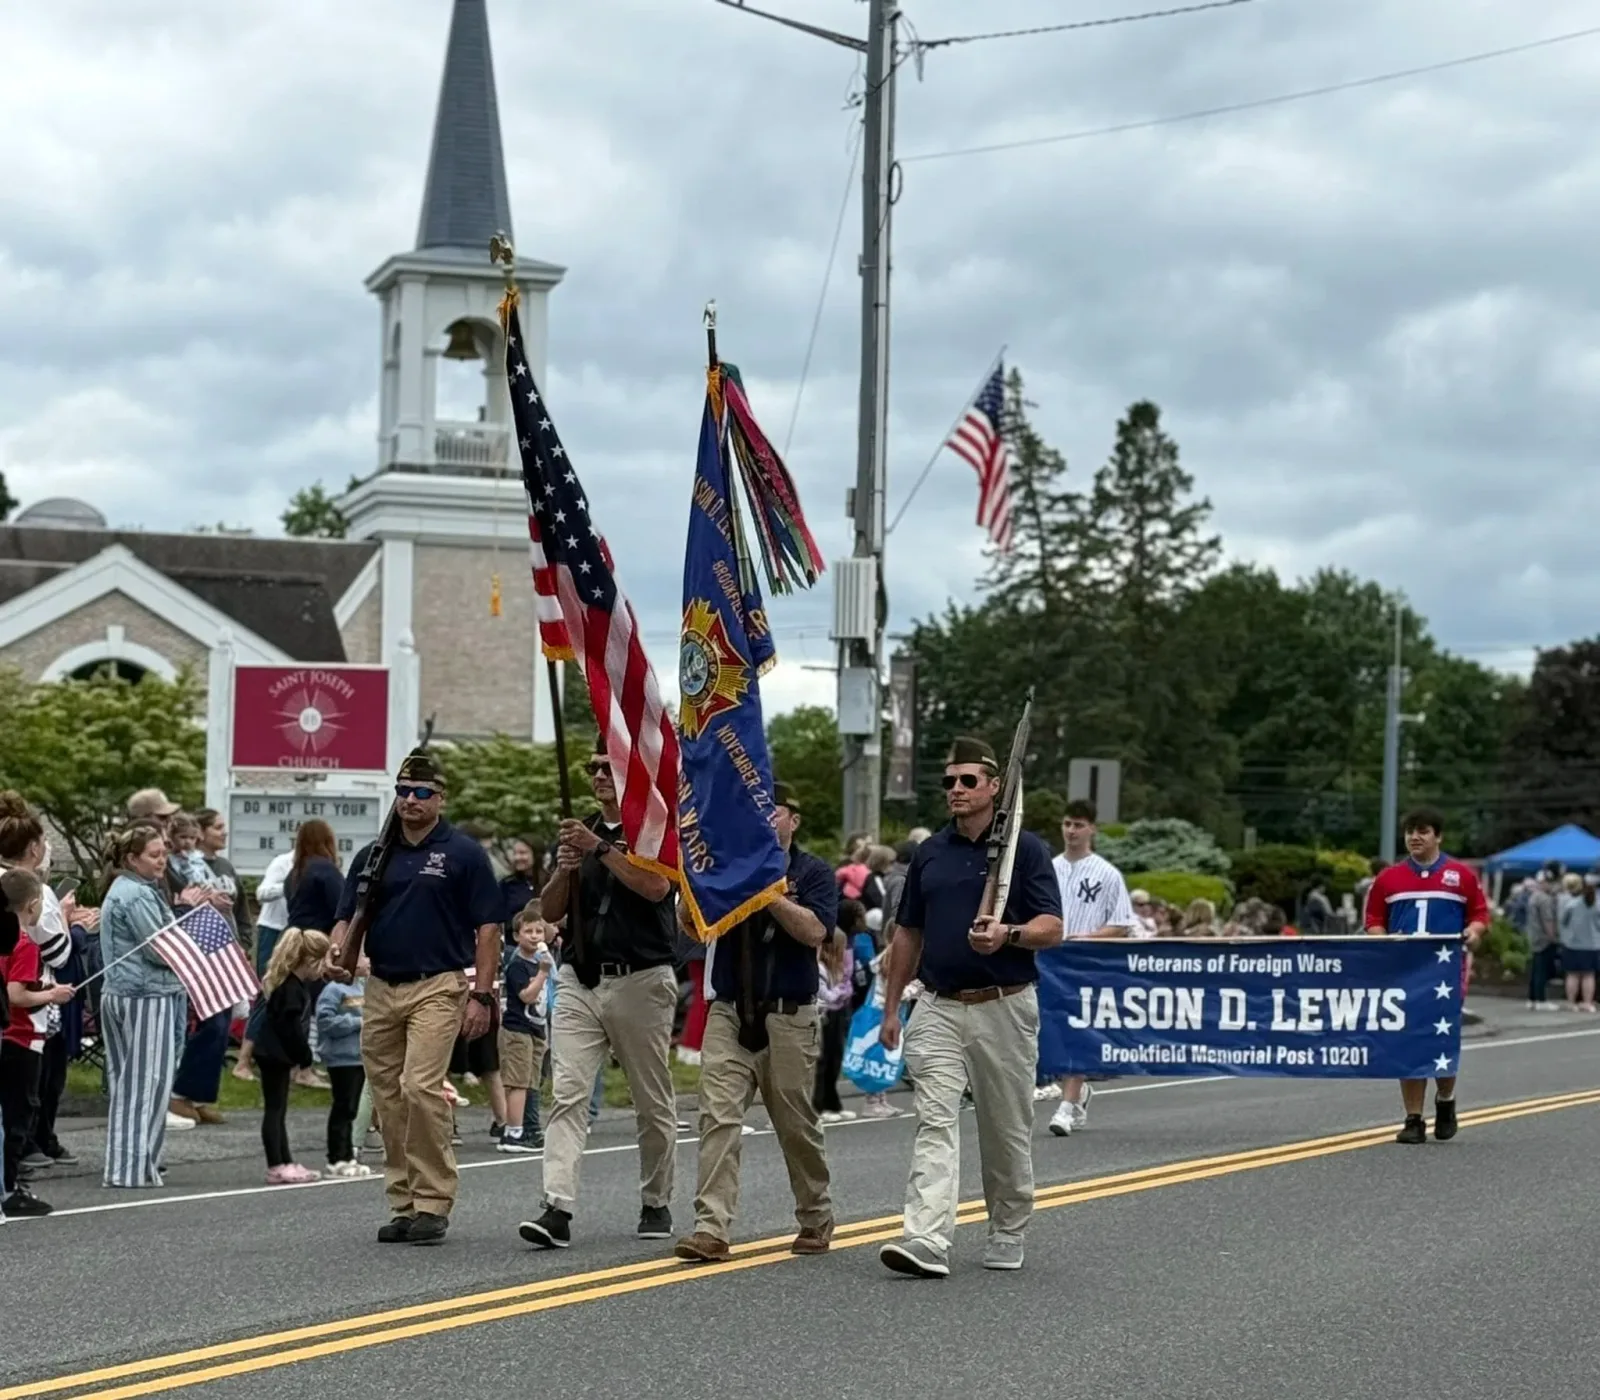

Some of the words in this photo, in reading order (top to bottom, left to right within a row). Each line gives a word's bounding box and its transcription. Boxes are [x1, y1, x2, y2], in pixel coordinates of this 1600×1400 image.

[268, 670, 307, 698] SAINT
[308, 670, 355, 699] JOSEPH
[278, 756, 340, 769] CHURCH
[716, 724, 762, 789] NOVEMBER
[243, 801, 260, 814] DO
[269, 802, 293, 814] NOT
[303, 803, 326, 816] LET
[333, 804, 368, 816] YOUR
[259, 836, 275, 850] BE
[680, 807, 714, 873] WARS
[1412, 899, 1430, 936] 1
[1127, 954, 1202, 973] Veterans
[1207, 954, 1226, 973] of
[1229, 954, 1292, 977] Foreign
[1297, 954, 1342, 973] Wars
[1068, 986, 1205, 1030] JASON
[1218, 988, 1257, 1031] D.
[1270, 988, 1407, 1031] LEWIS
[1101, 1043, 1187, 1063] Brookfield
[1192, 1045, 1271, 1065] Memorial
[1276, 1046, 1314, 1065] Post
[1320, 1047, 1369, 1065] 10201
